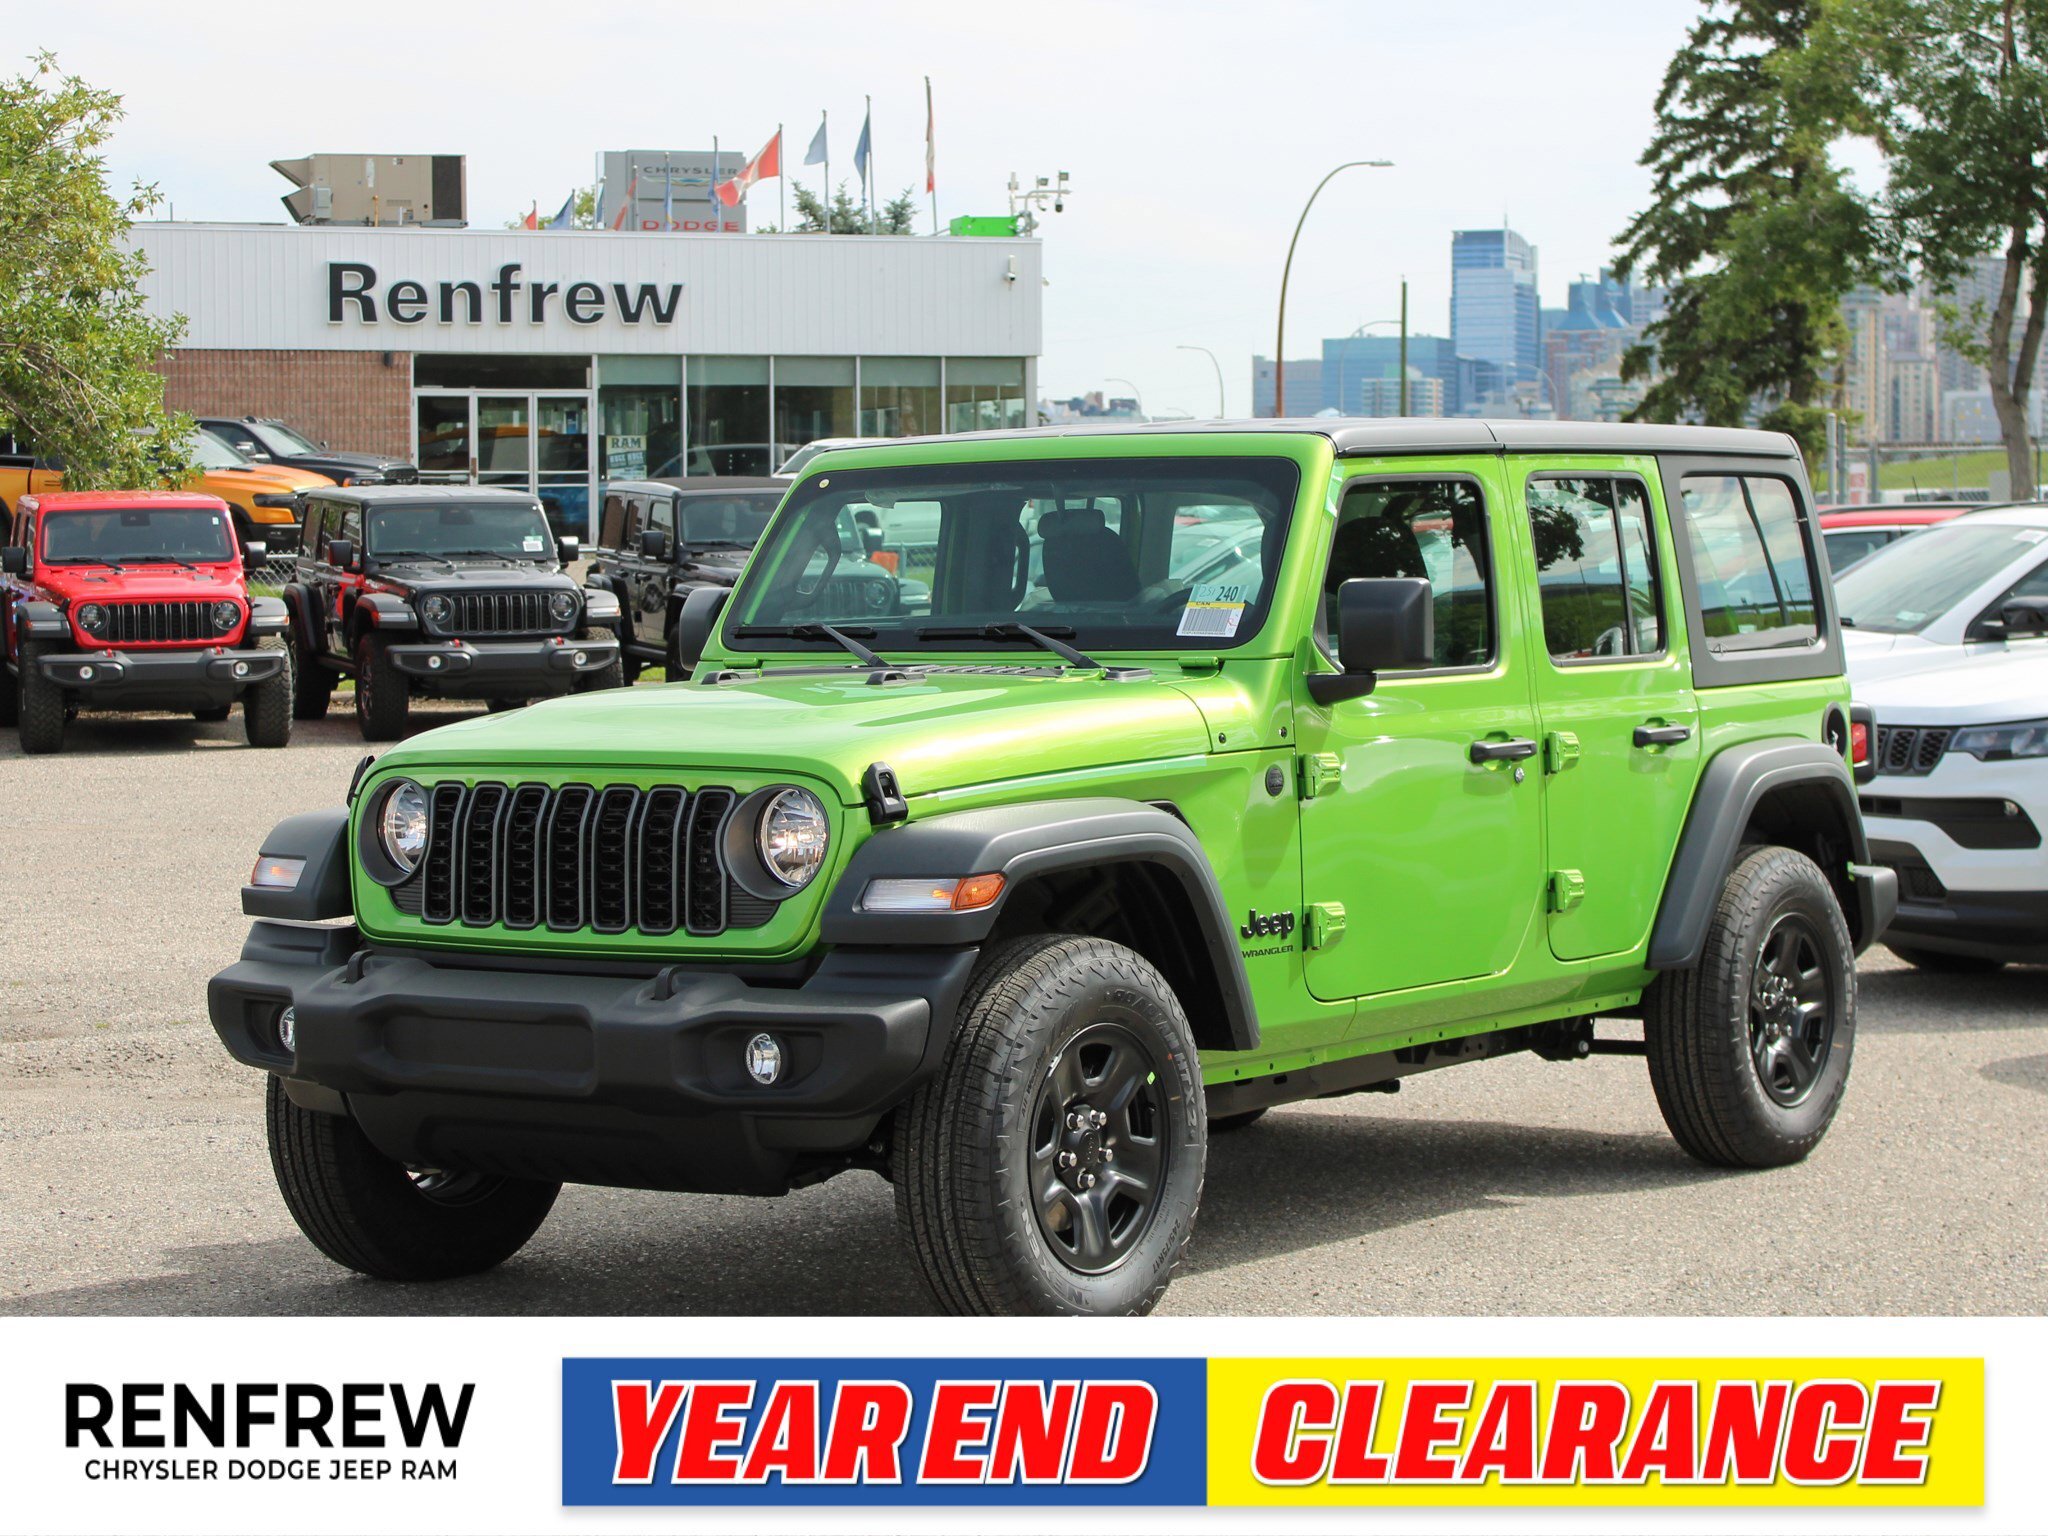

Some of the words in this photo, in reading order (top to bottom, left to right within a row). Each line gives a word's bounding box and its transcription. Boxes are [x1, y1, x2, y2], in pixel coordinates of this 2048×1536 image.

[642, 220, 739, 232] DODGE
[328, 261, 684, 325] Renfrew
[611, 437, 641, 449] RAM
[1215, 586, 1239, 602] 240
[1241, 909, 1295, 940] Jeep
[1241, 944, 1294, 958] WRANGLER
[1020, 1208, 1086, 1305] NEXEN
[1152, 1218, 1182, 1275] 245/75R17
